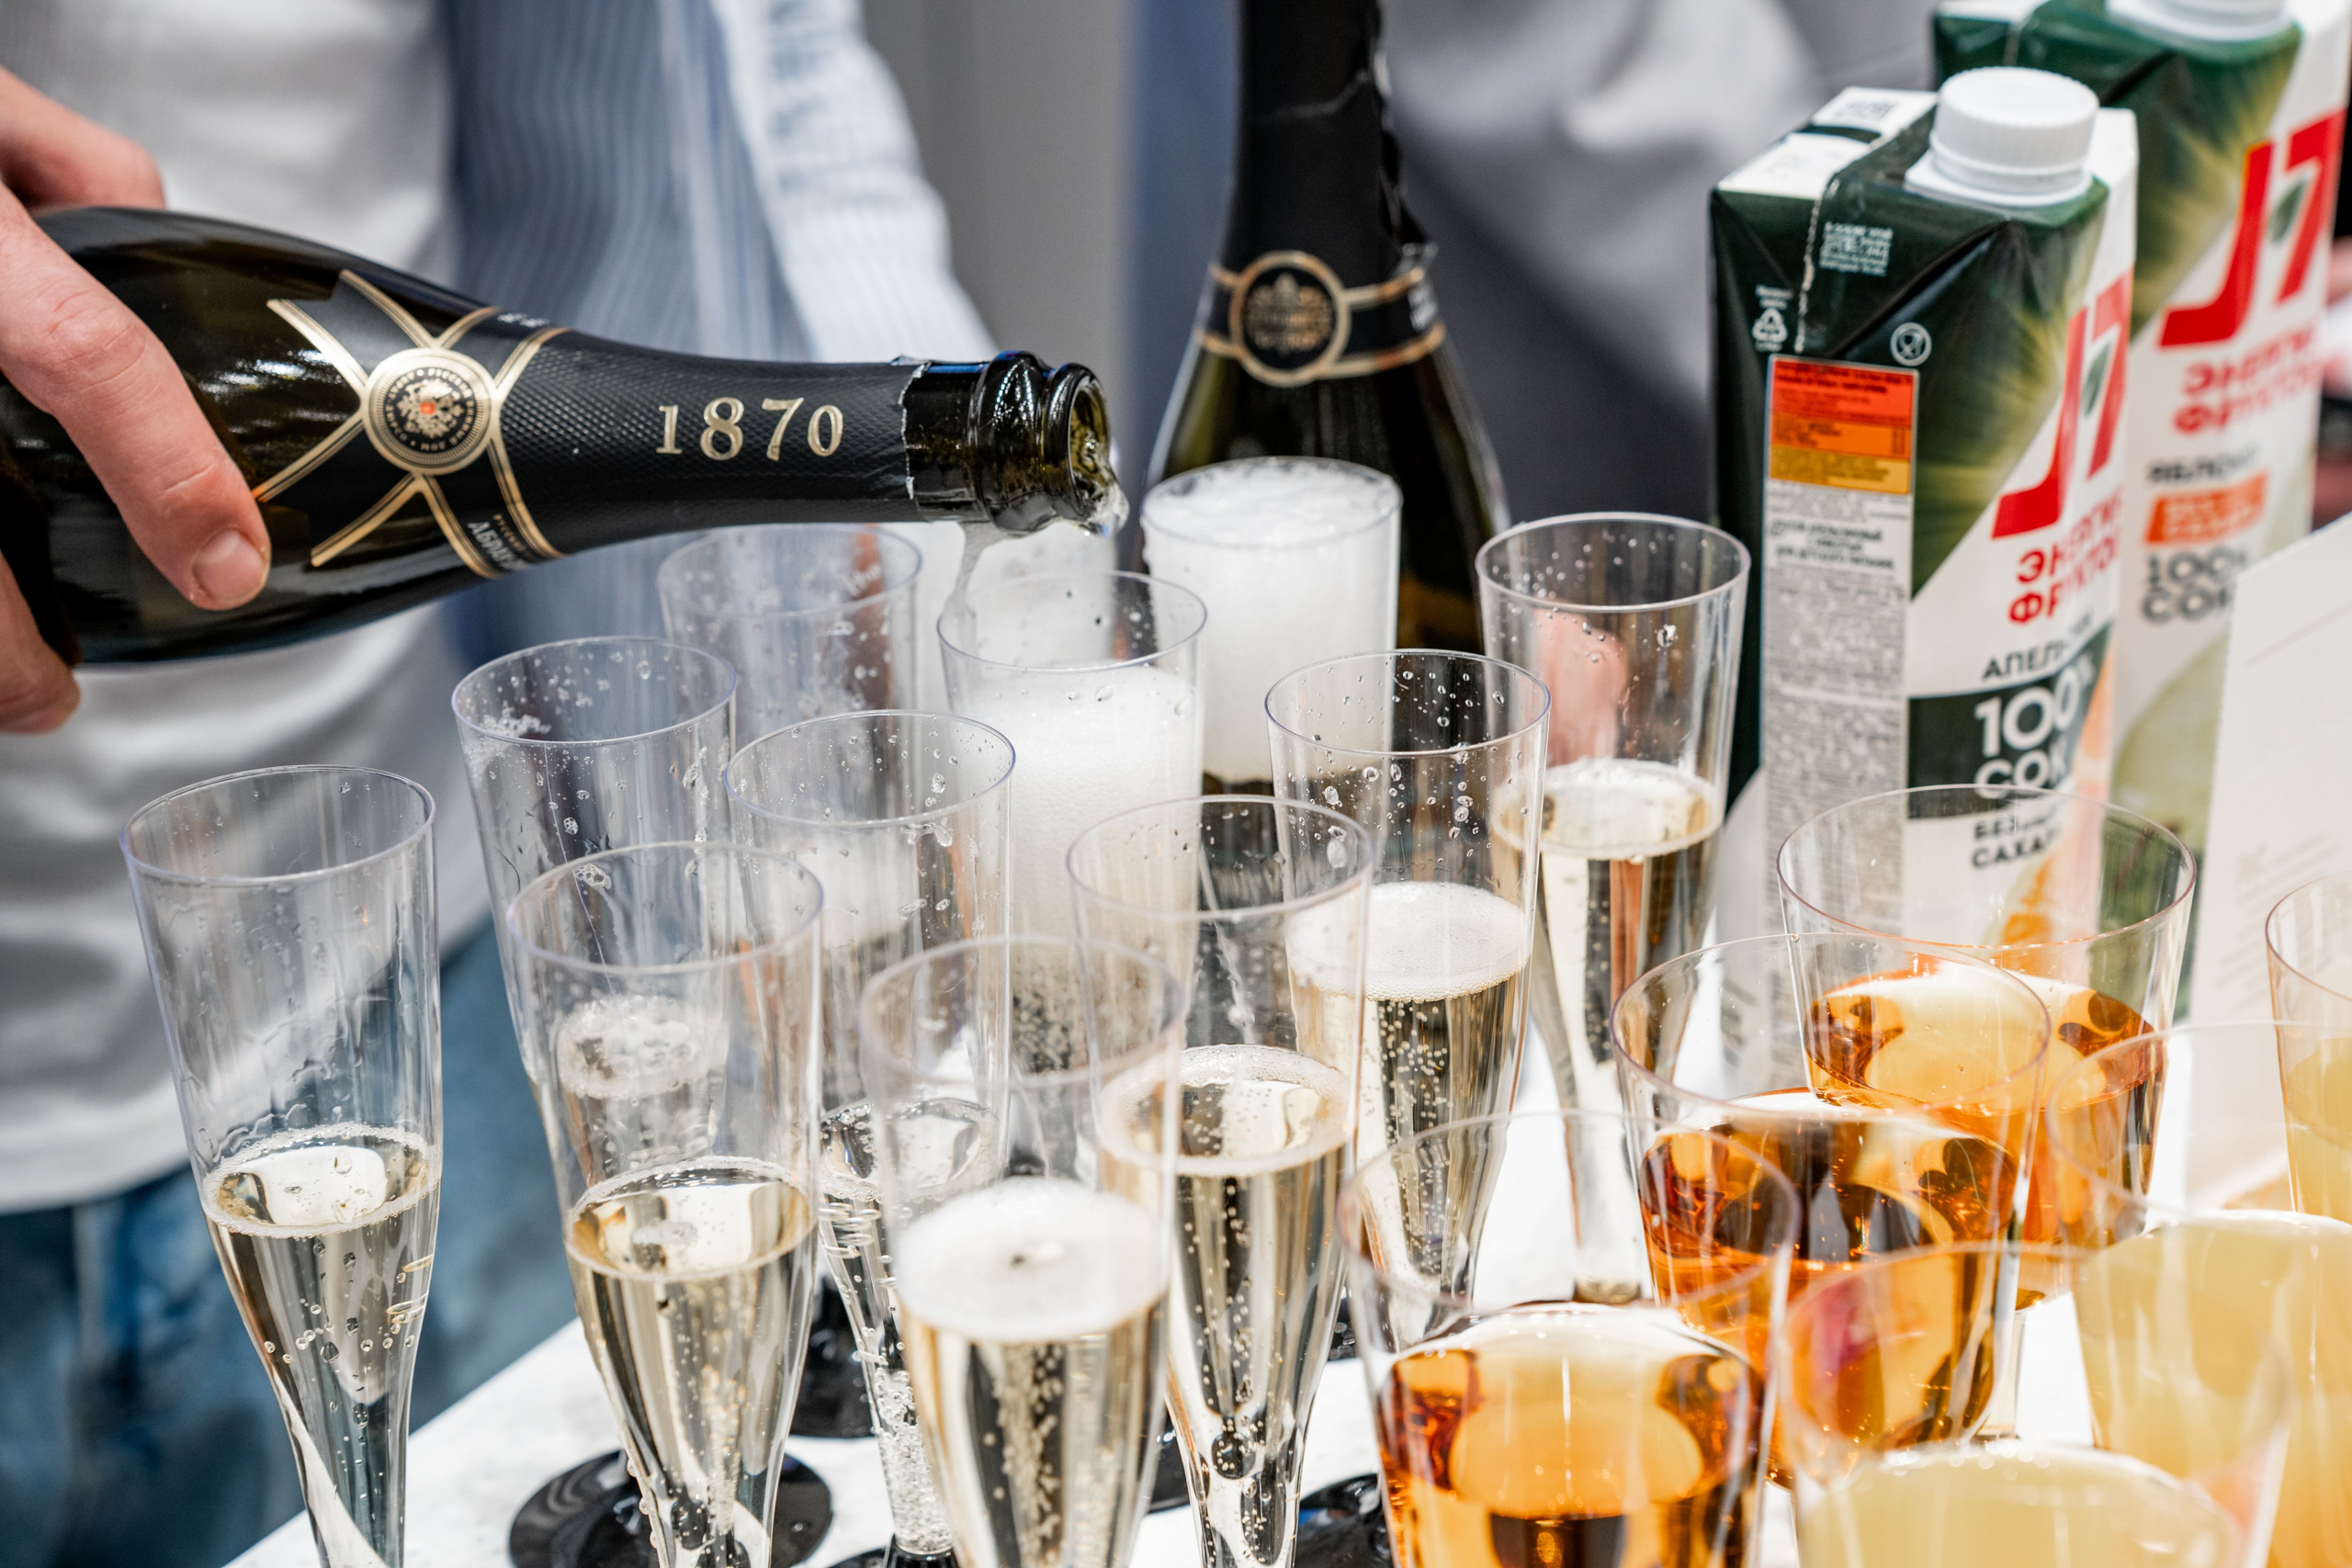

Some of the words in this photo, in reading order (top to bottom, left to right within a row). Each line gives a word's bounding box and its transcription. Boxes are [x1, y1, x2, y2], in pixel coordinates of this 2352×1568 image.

[2158, 107, 2346, 349] J7
[655, 397, 843, 461] 1870
[1991, 272, 2132, 539] J7
